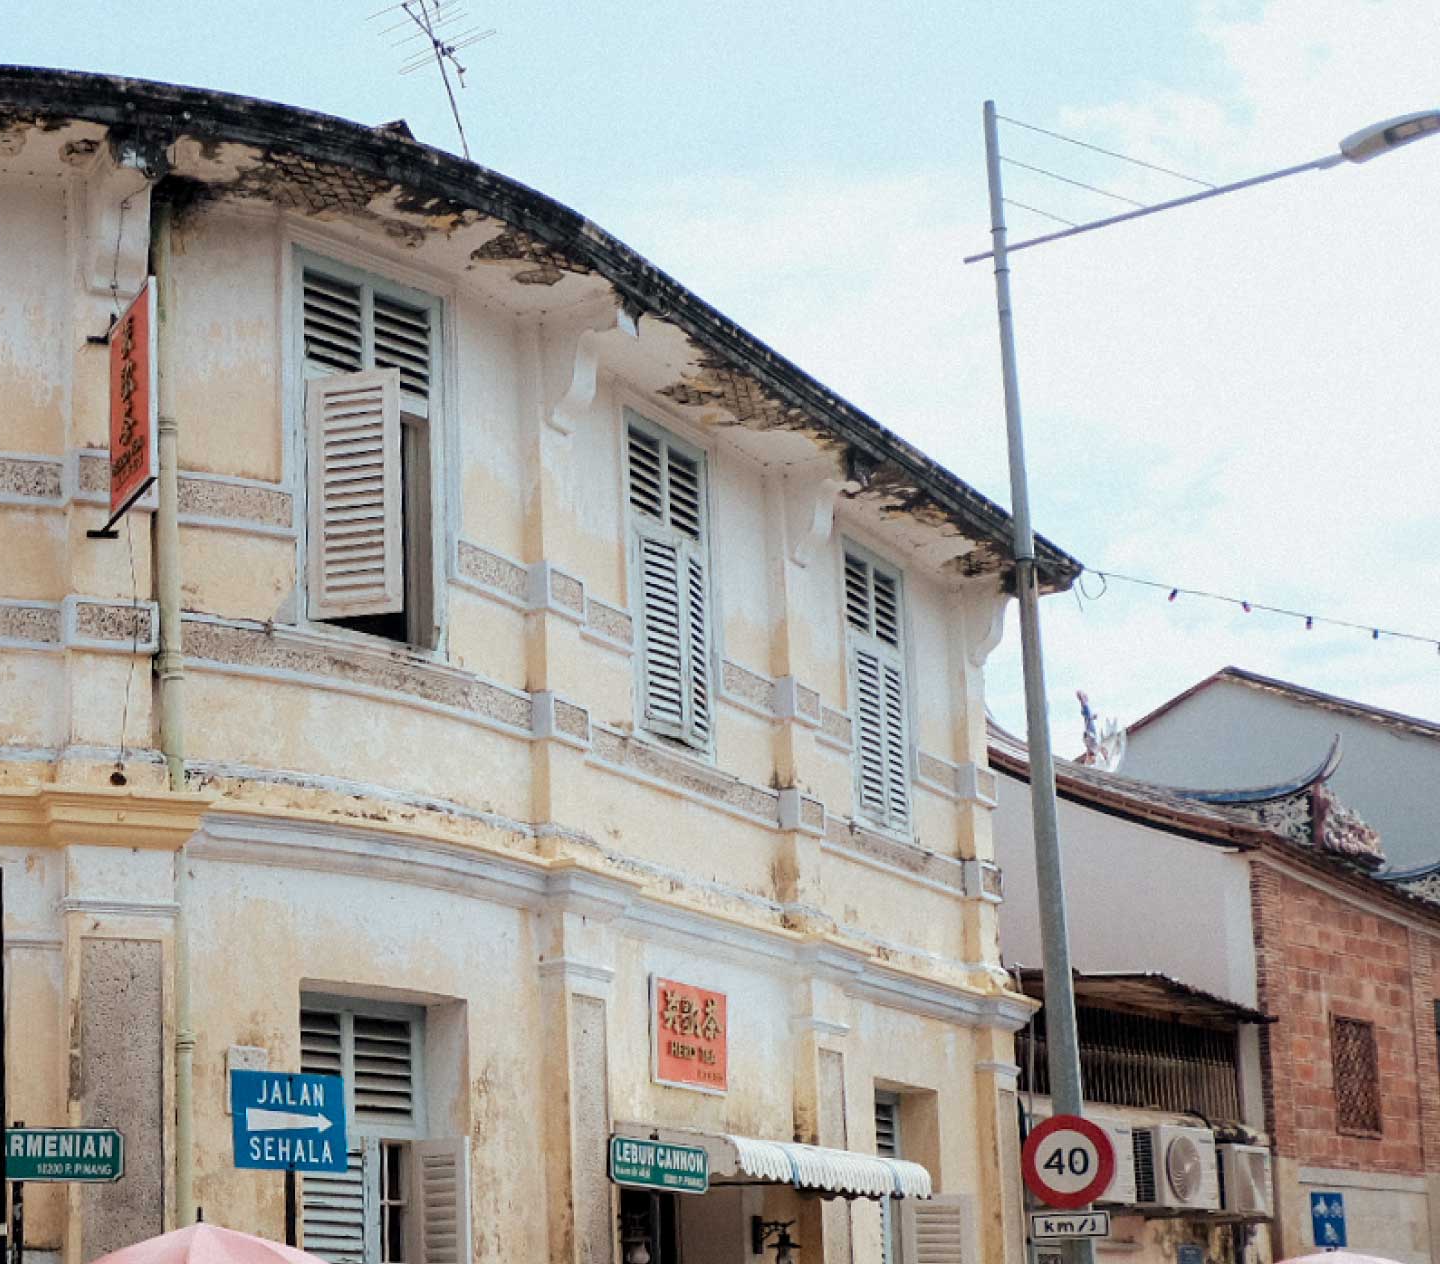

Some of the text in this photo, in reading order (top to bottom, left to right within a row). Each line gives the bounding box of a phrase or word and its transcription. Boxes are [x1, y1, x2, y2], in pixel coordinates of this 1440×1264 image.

[257, 1079, 325, 1107] JALAN
[5, 1134, 113, 1158] RMENIAN
[249, 1135, 334, 1164] SEHALA
[615, 1140, 655, 1166] LEBUH
[656, 1145, 704, 1173] CANNON
[1042, 1147, 1089, 1175] 40
